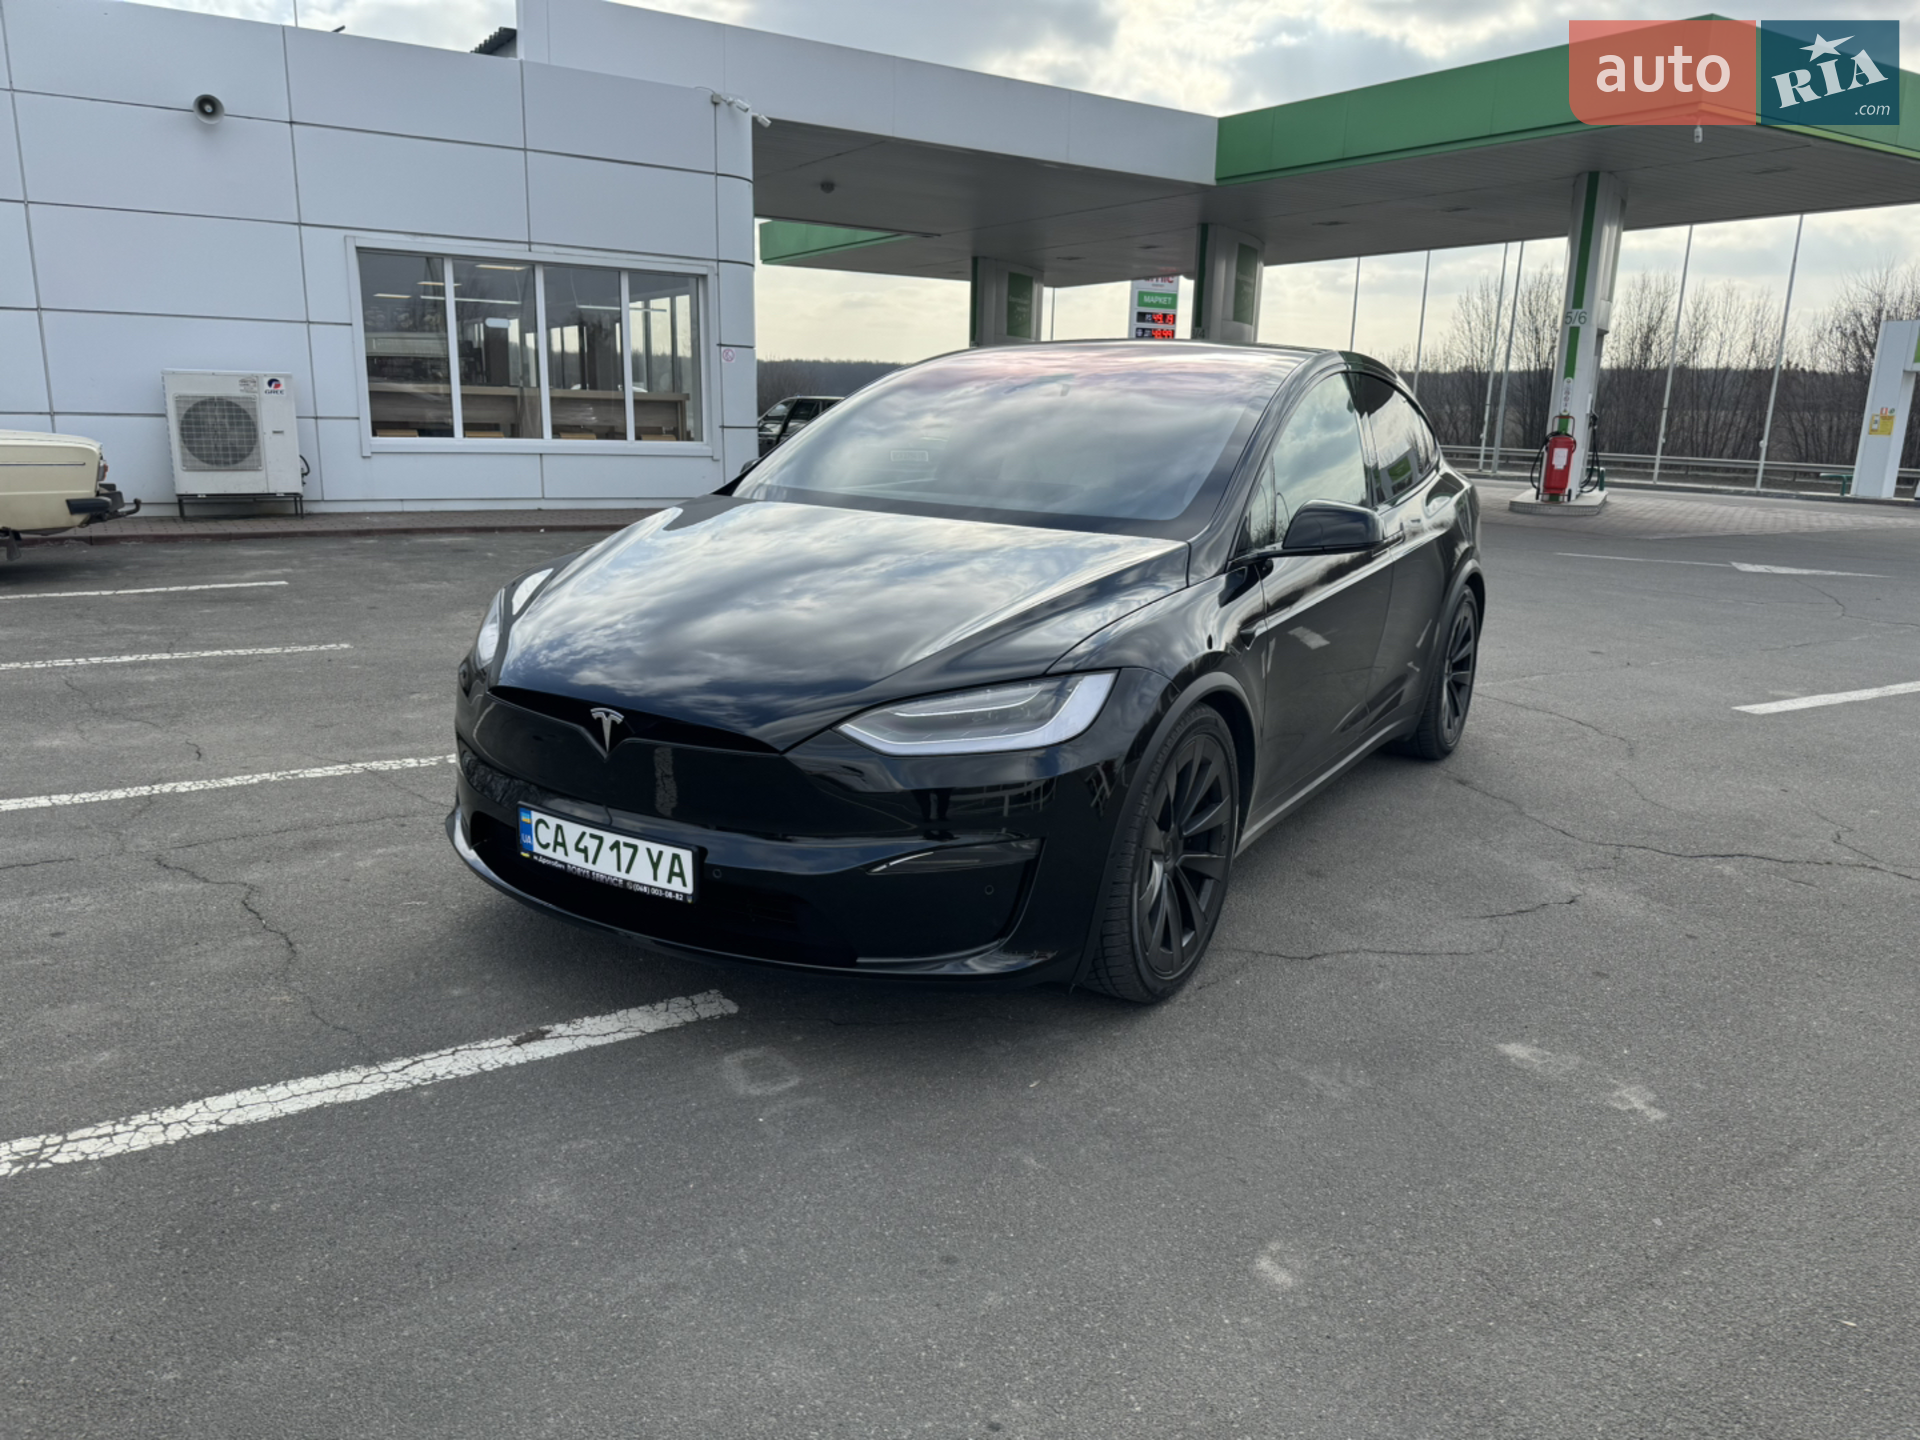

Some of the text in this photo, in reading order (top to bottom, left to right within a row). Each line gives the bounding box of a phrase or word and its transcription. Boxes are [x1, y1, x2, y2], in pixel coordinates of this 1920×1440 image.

[1564, 310, 1587, 326] 5/6
[521, 833, 533, 845] UA
[534, 818, 688, 888] CA 4717 YA
[591, 870, 625, 888] SERVICE
